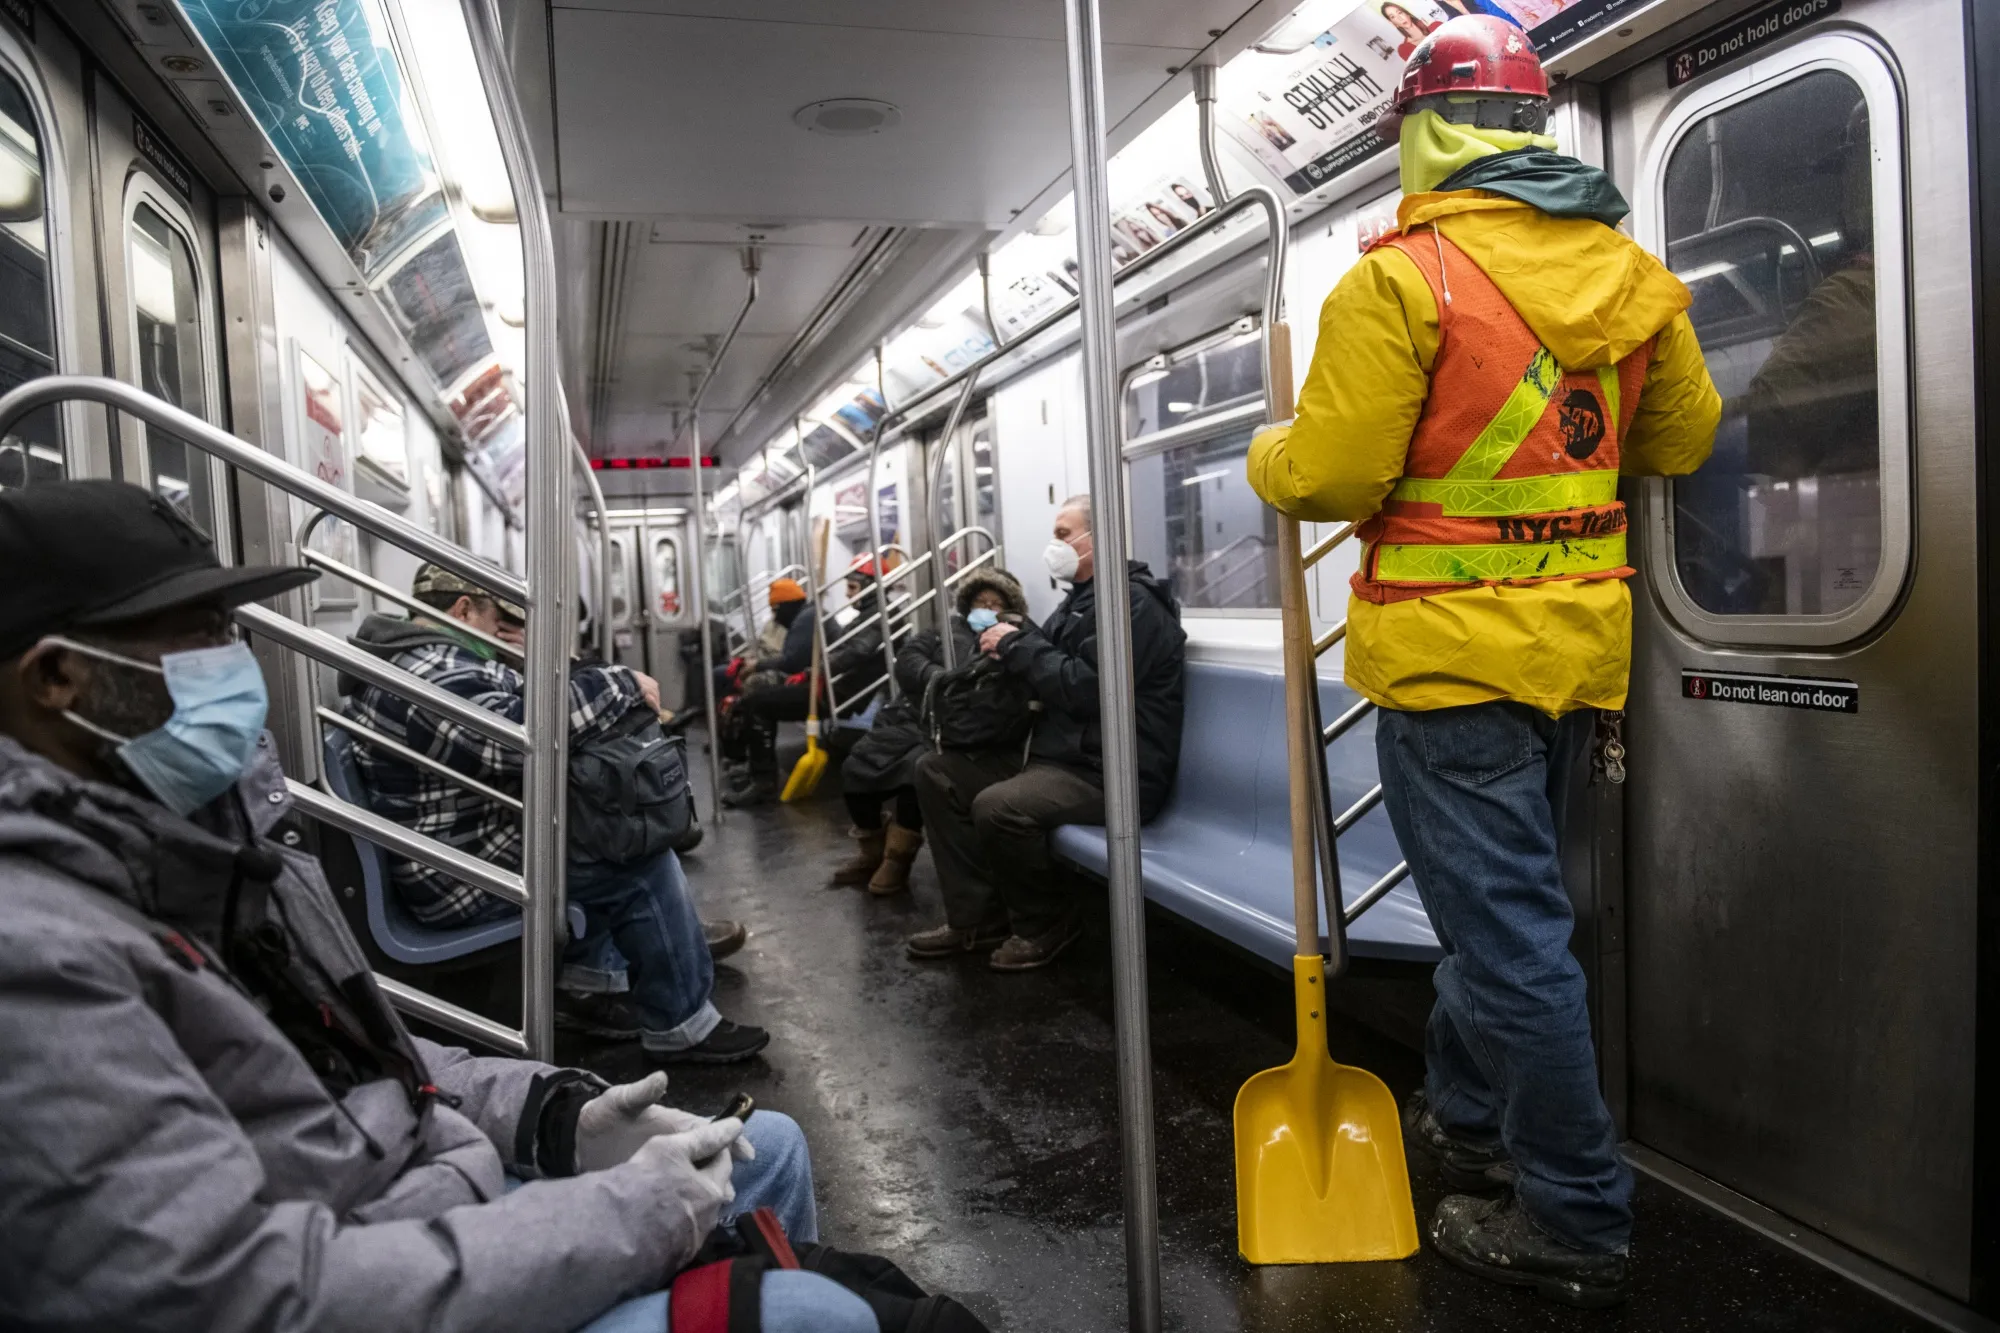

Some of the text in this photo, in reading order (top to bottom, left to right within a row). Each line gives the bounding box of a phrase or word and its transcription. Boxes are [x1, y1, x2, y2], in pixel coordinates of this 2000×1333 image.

[284, 16, 310, 45] It's
[1698, 0, 1828, 66] Do not hold doors
[298, 47, 323, 80] way
[310, 69, 328, 89] to
[313, 0, 382, 137] Keep your face covering on.
[314, 78, 337, 112] keep
[1283, 52, 1384, 130] STYLISH
[326, 106, 352, 141] others
[1322, 153, 1351, 174] SUPPORTS
[1349, 145, 1363, 157] FILM
[1362, 143, 1369, 151] &
[1367, 138, 1377, 147] TV
[1497, 516, 1576, 543] NYC
[1712, 681, 1849, 708] Do not lean on door
